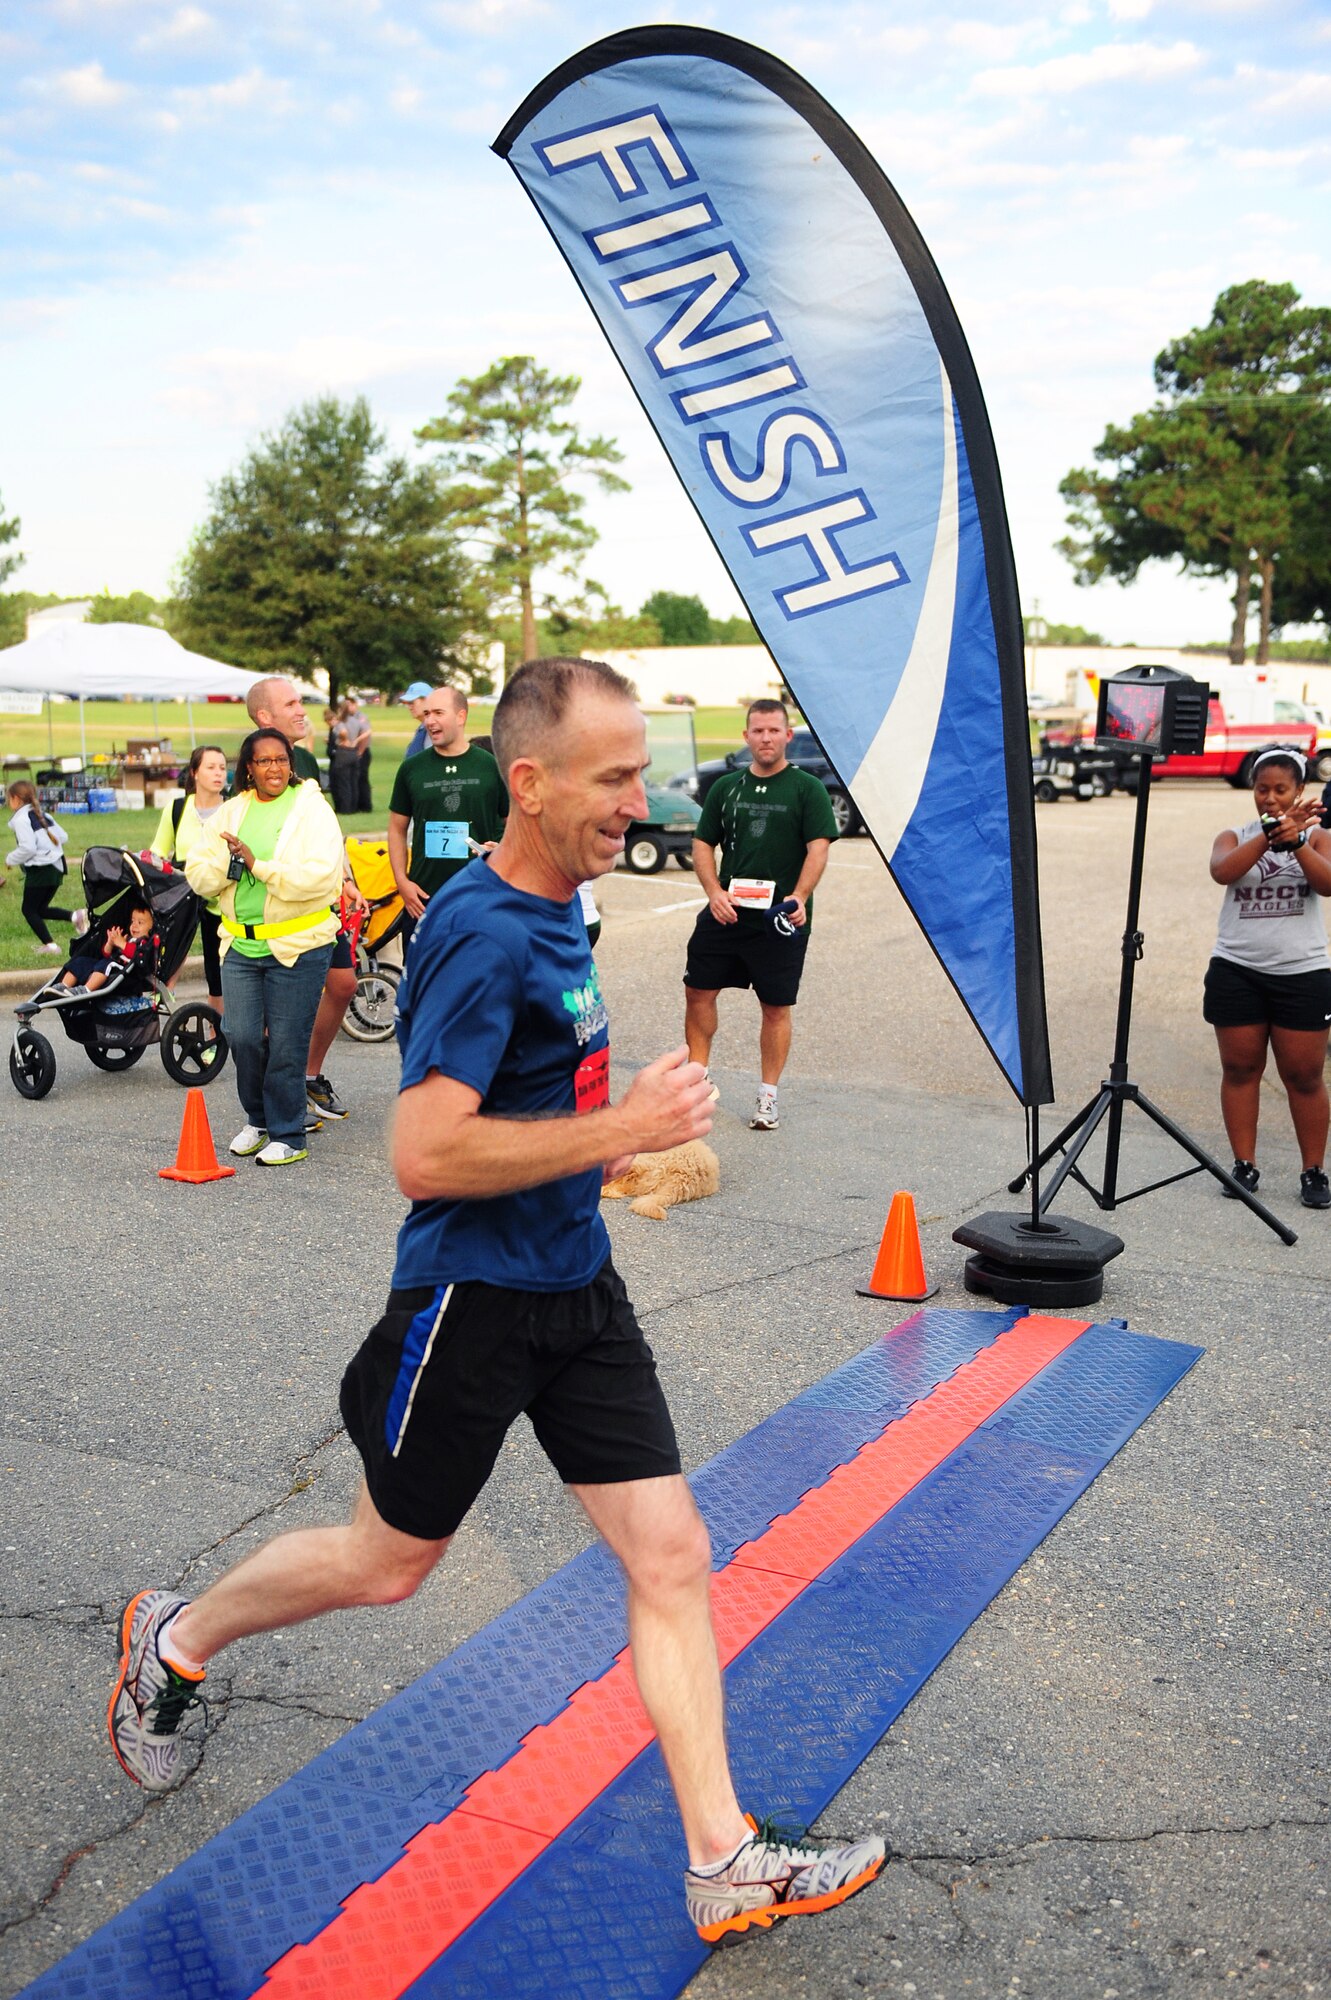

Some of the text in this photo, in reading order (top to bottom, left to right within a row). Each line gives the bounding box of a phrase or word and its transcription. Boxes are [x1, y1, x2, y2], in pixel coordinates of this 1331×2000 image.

[531, 104, 911, 621] FINISH
[442, 838, 449, 851] 7
[1233, 884, 1311, 902] NCCU
[1240, 900, 1304, 912] EAGLES
